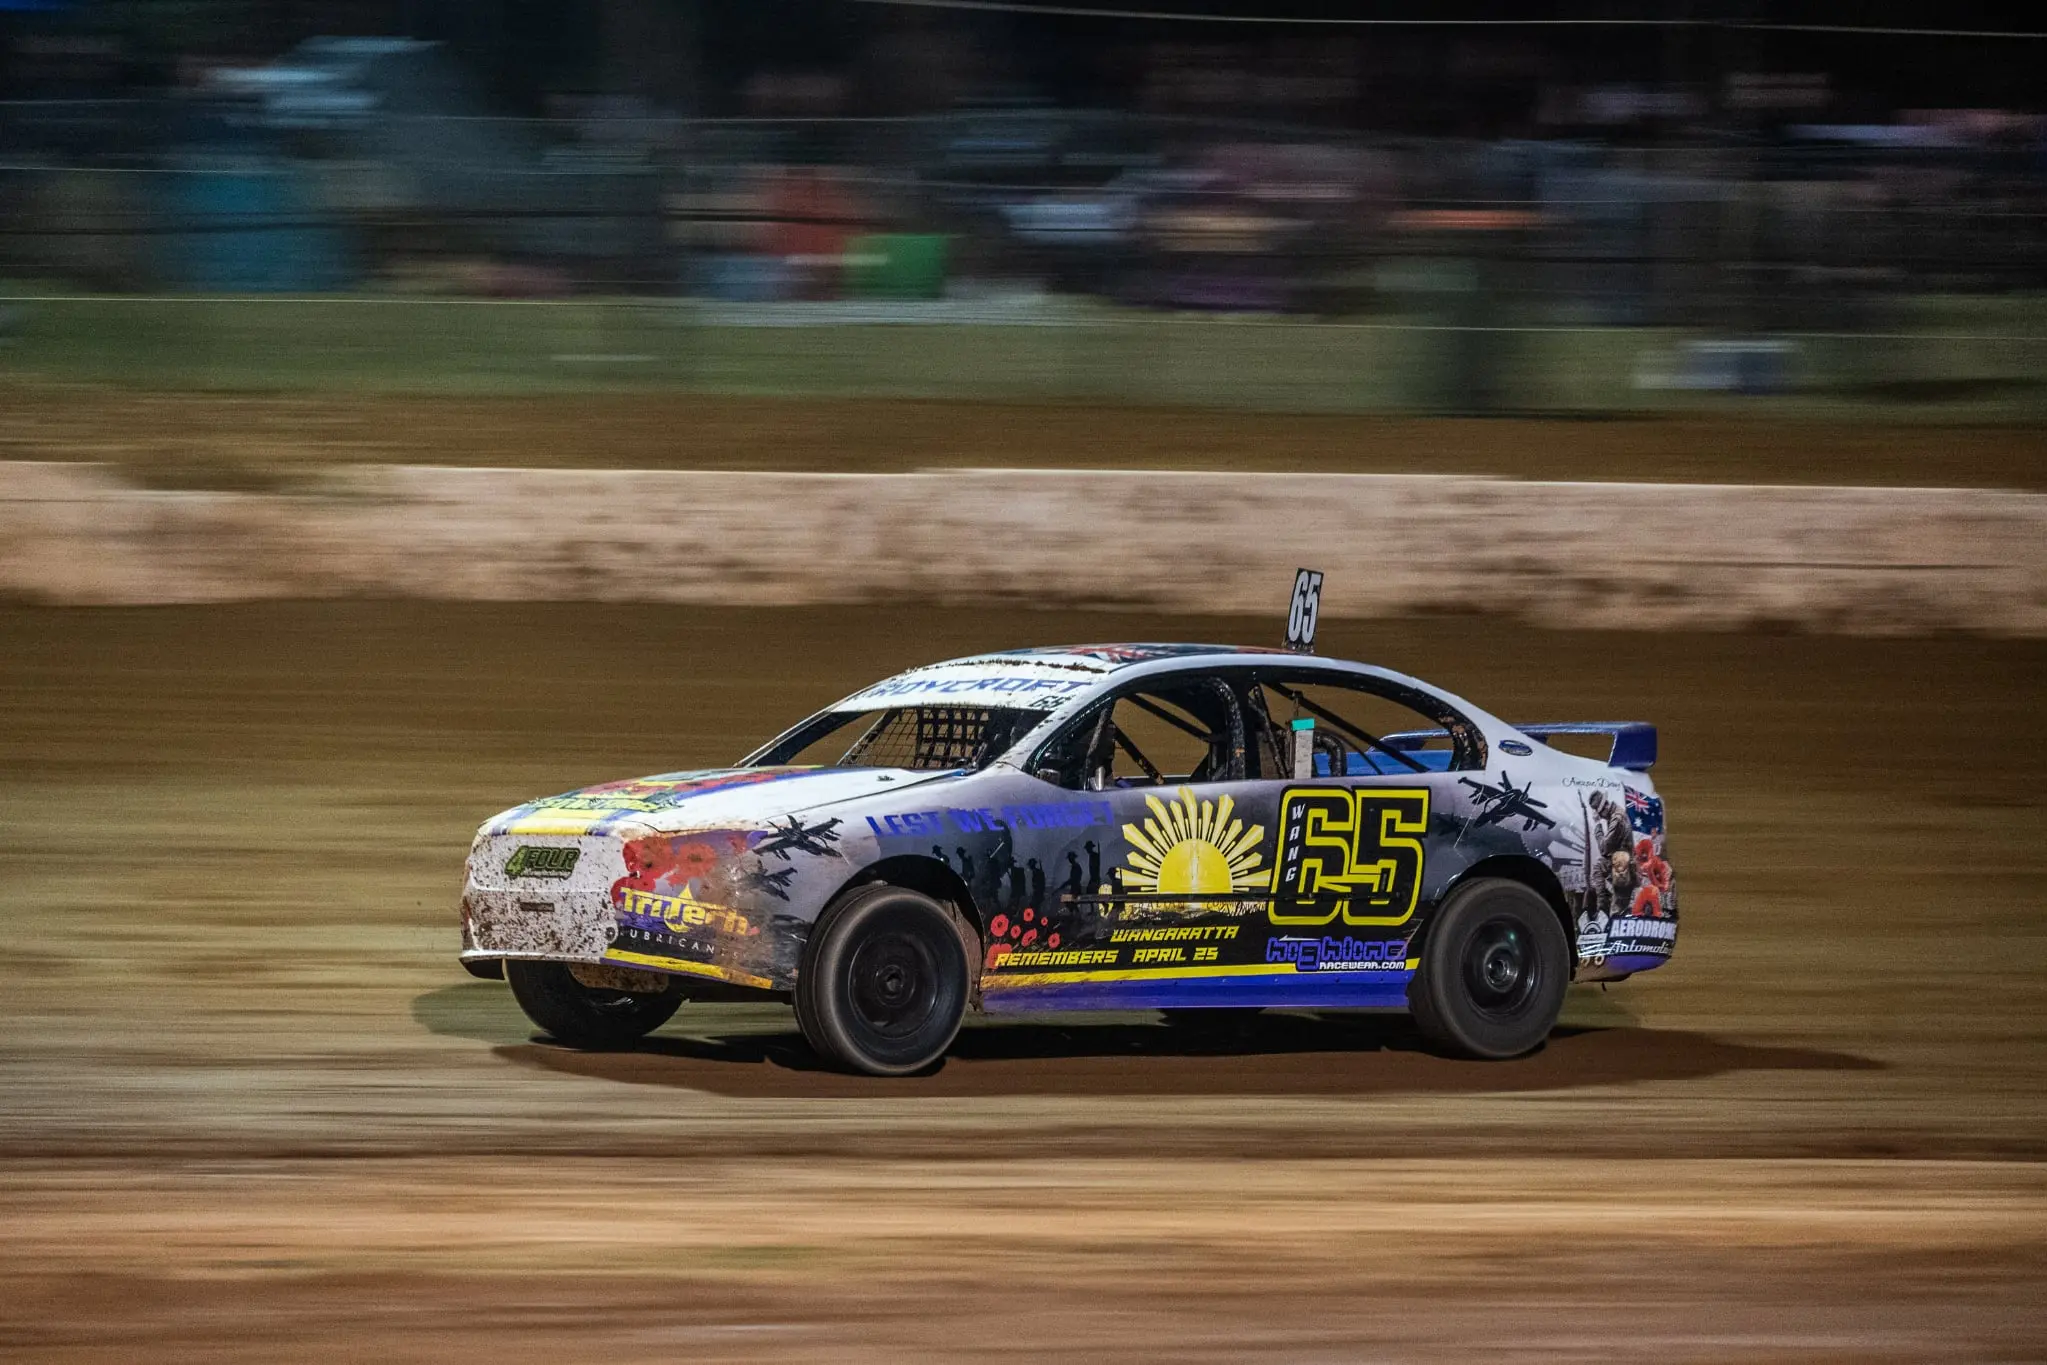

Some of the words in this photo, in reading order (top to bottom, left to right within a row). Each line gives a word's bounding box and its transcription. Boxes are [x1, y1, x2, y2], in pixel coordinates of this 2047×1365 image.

[1288, 570, 1322, 645] 65
[865, 811, 945, 837] LEST
[949, 807, 1004, 834] WE
[1267, 787, 1430, 928] 65
[1109, 925, 1240, 943] WANGARATTA
[994, 949, 1119, 968] REMEMBERS
[1132, 948, 1187, 963] APRIL
[1192, 946, 1219, 961] 25
